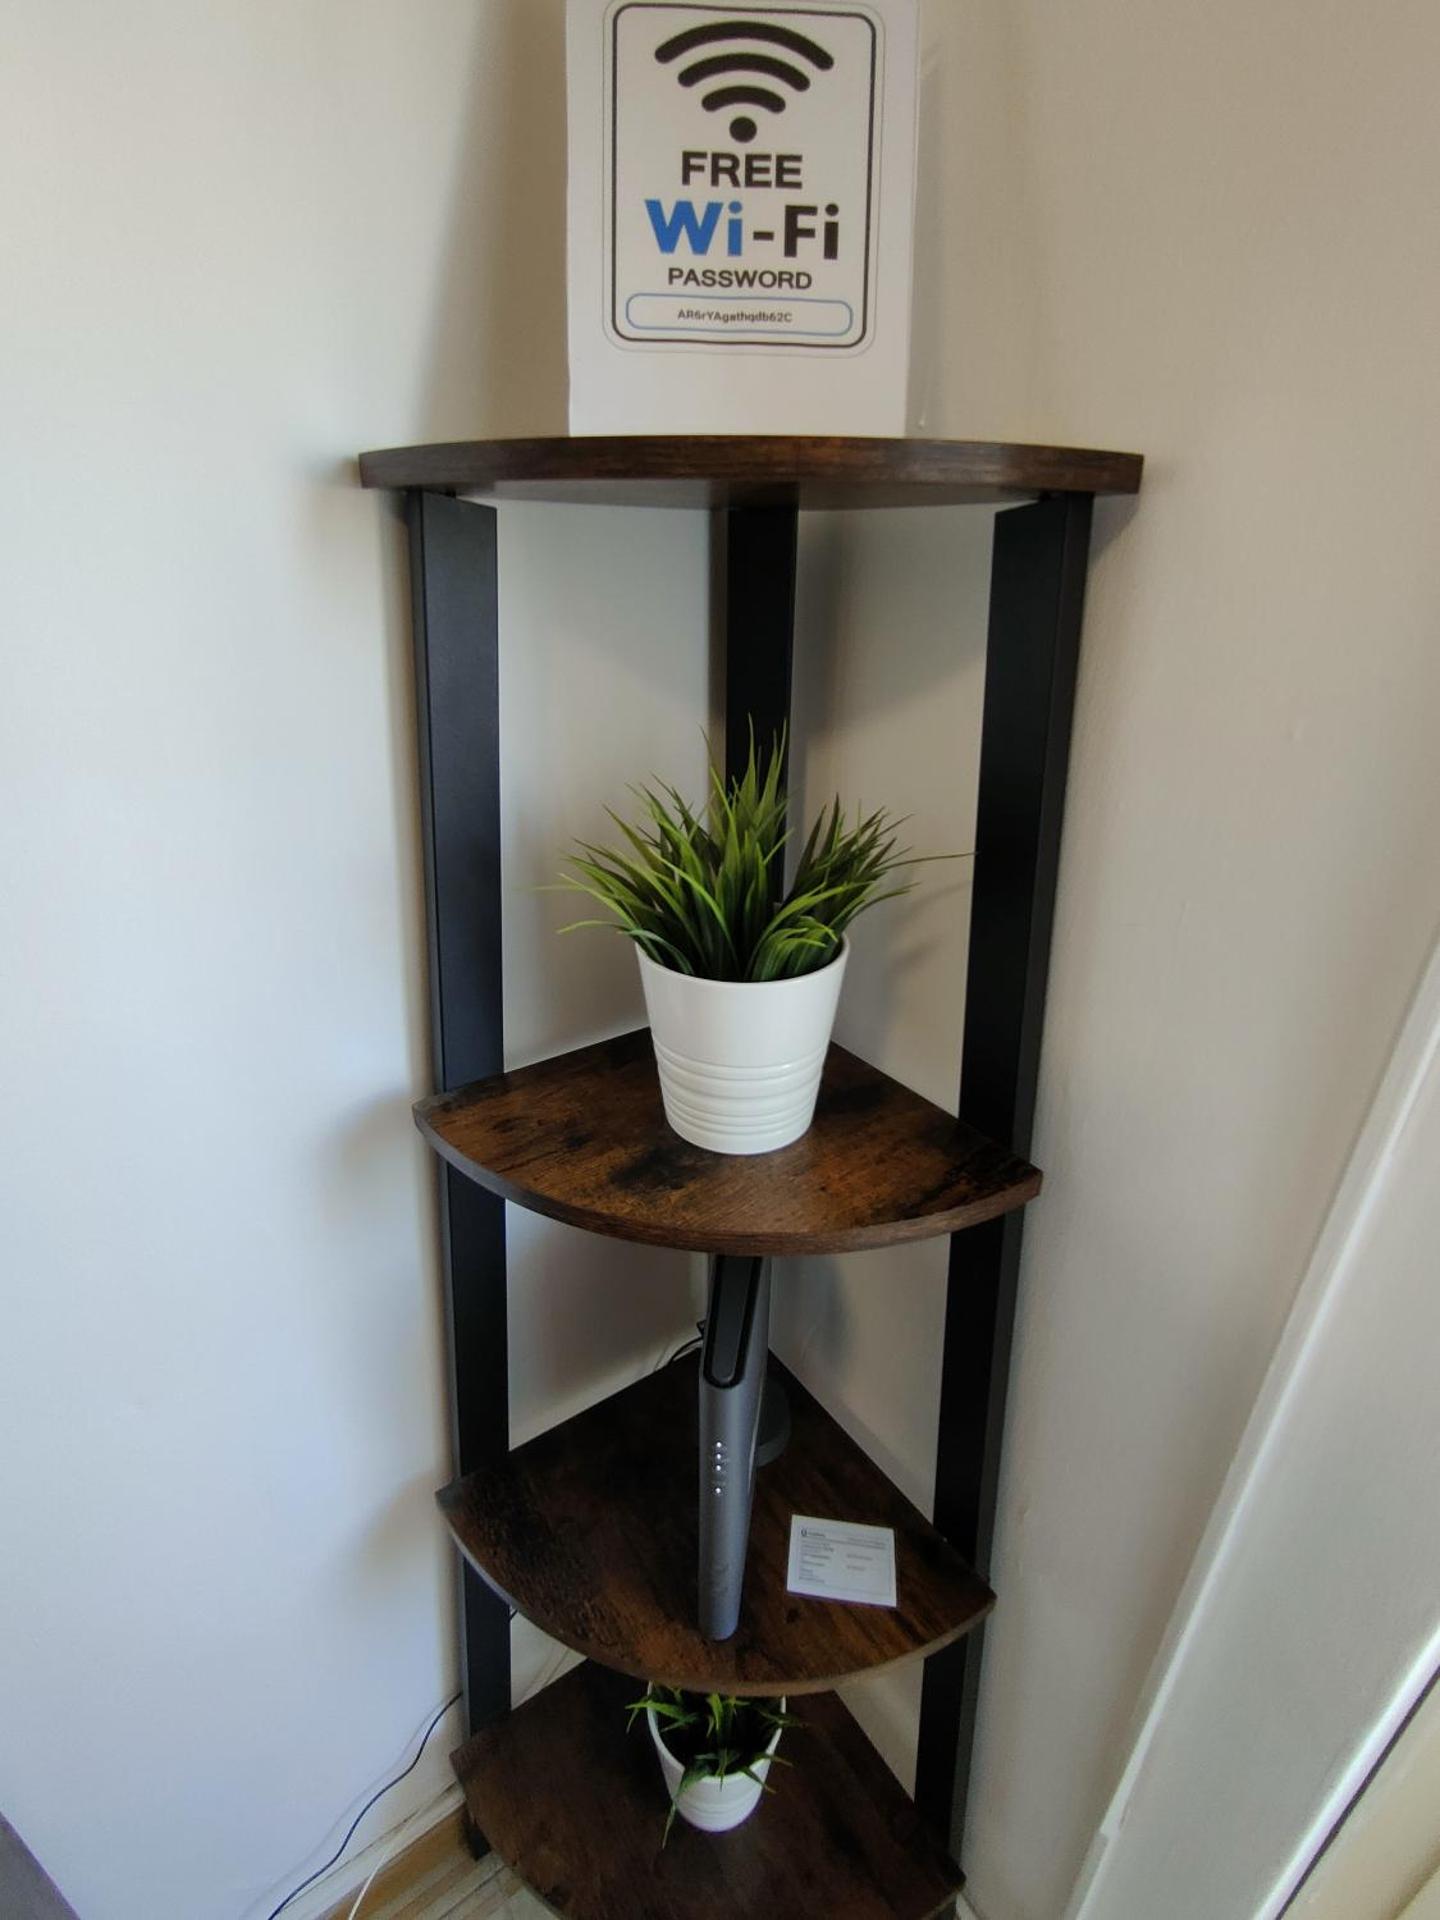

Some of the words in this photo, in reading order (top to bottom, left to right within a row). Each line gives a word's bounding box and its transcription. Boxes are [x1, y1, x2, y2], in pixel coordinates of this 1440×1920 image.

[681, 150, 803, 189] FREE
[644, 198, 839, 260] Wi-Fi
[667, 267, 812, 290] PASSWORD
